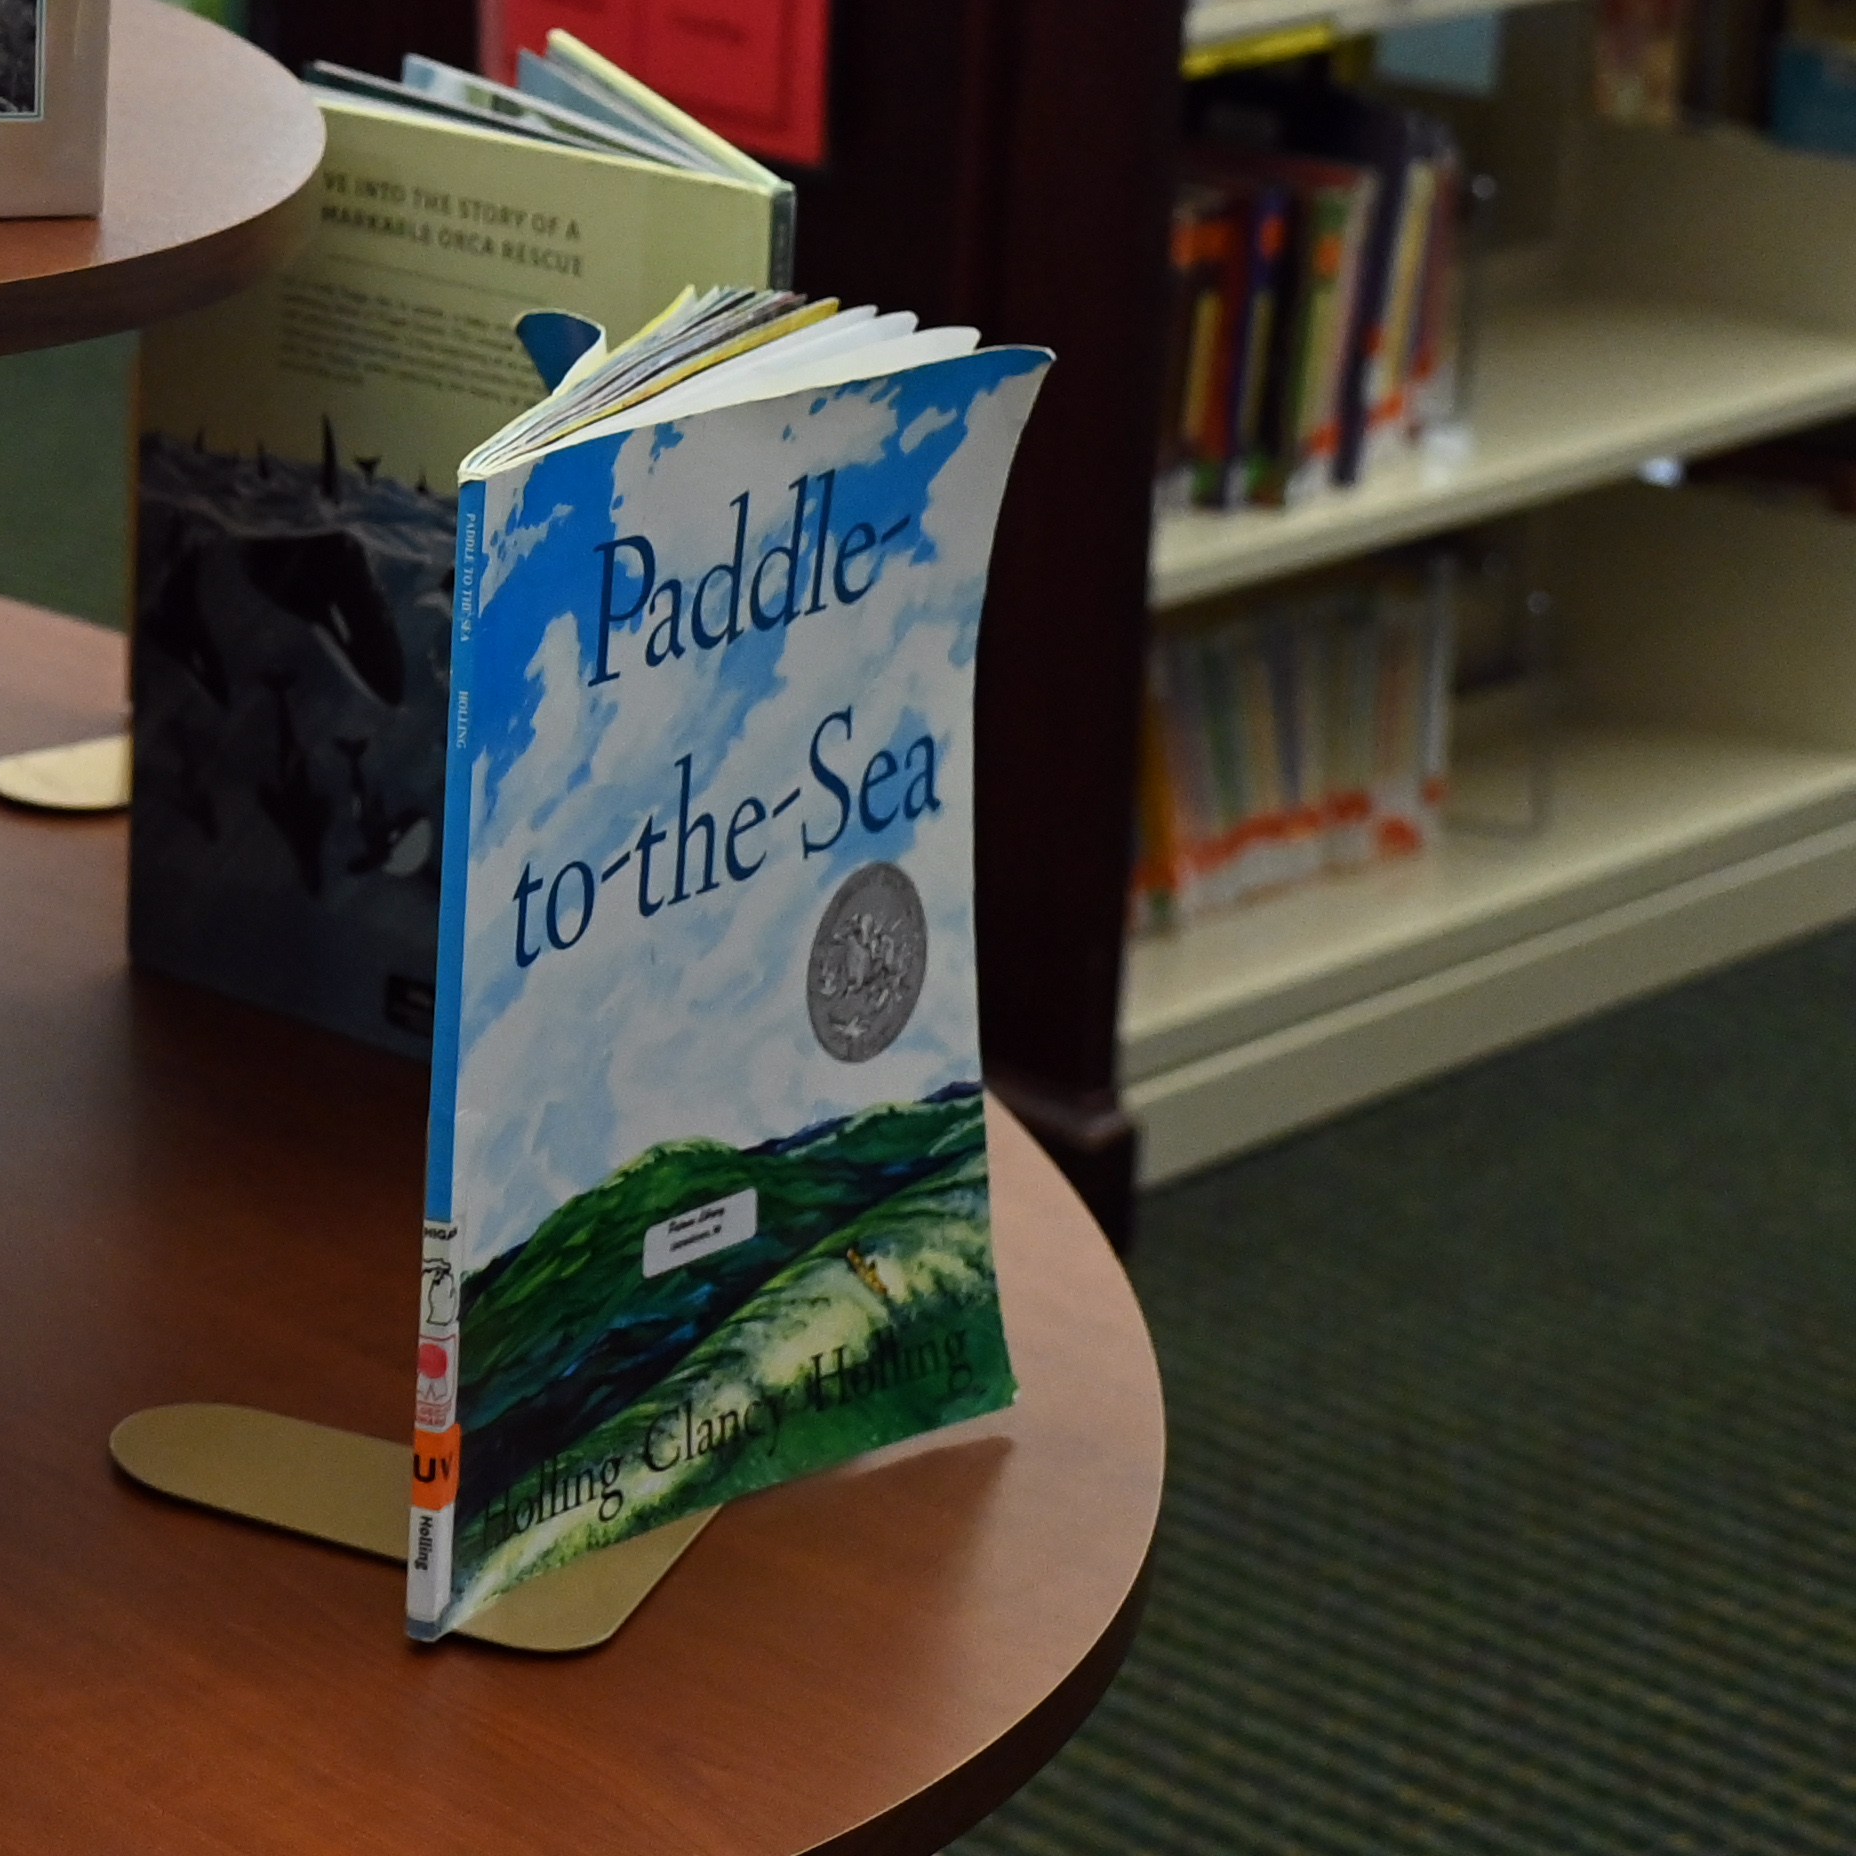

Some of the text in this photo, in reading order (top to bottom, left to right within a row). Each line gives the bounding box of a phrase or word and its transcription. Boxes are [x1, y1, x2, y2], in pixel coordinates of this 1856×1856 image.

[412, 185, 450, 216] THE
[458, 198, 528, 228] STORY
[531, 211, 559, 238] OF
[565, 218, 581, 240] A
[438, 223, 493, 254] ORCA
[500, 239, 582, 279] RESCUE
[588, 468, 911, 688] Paddle-
[513, 705, 941, 969] to-the-Sea
[482, 1324, 974, 1544] Holling Clancy Holling
[414, 1515, 433, 1572] Holling
